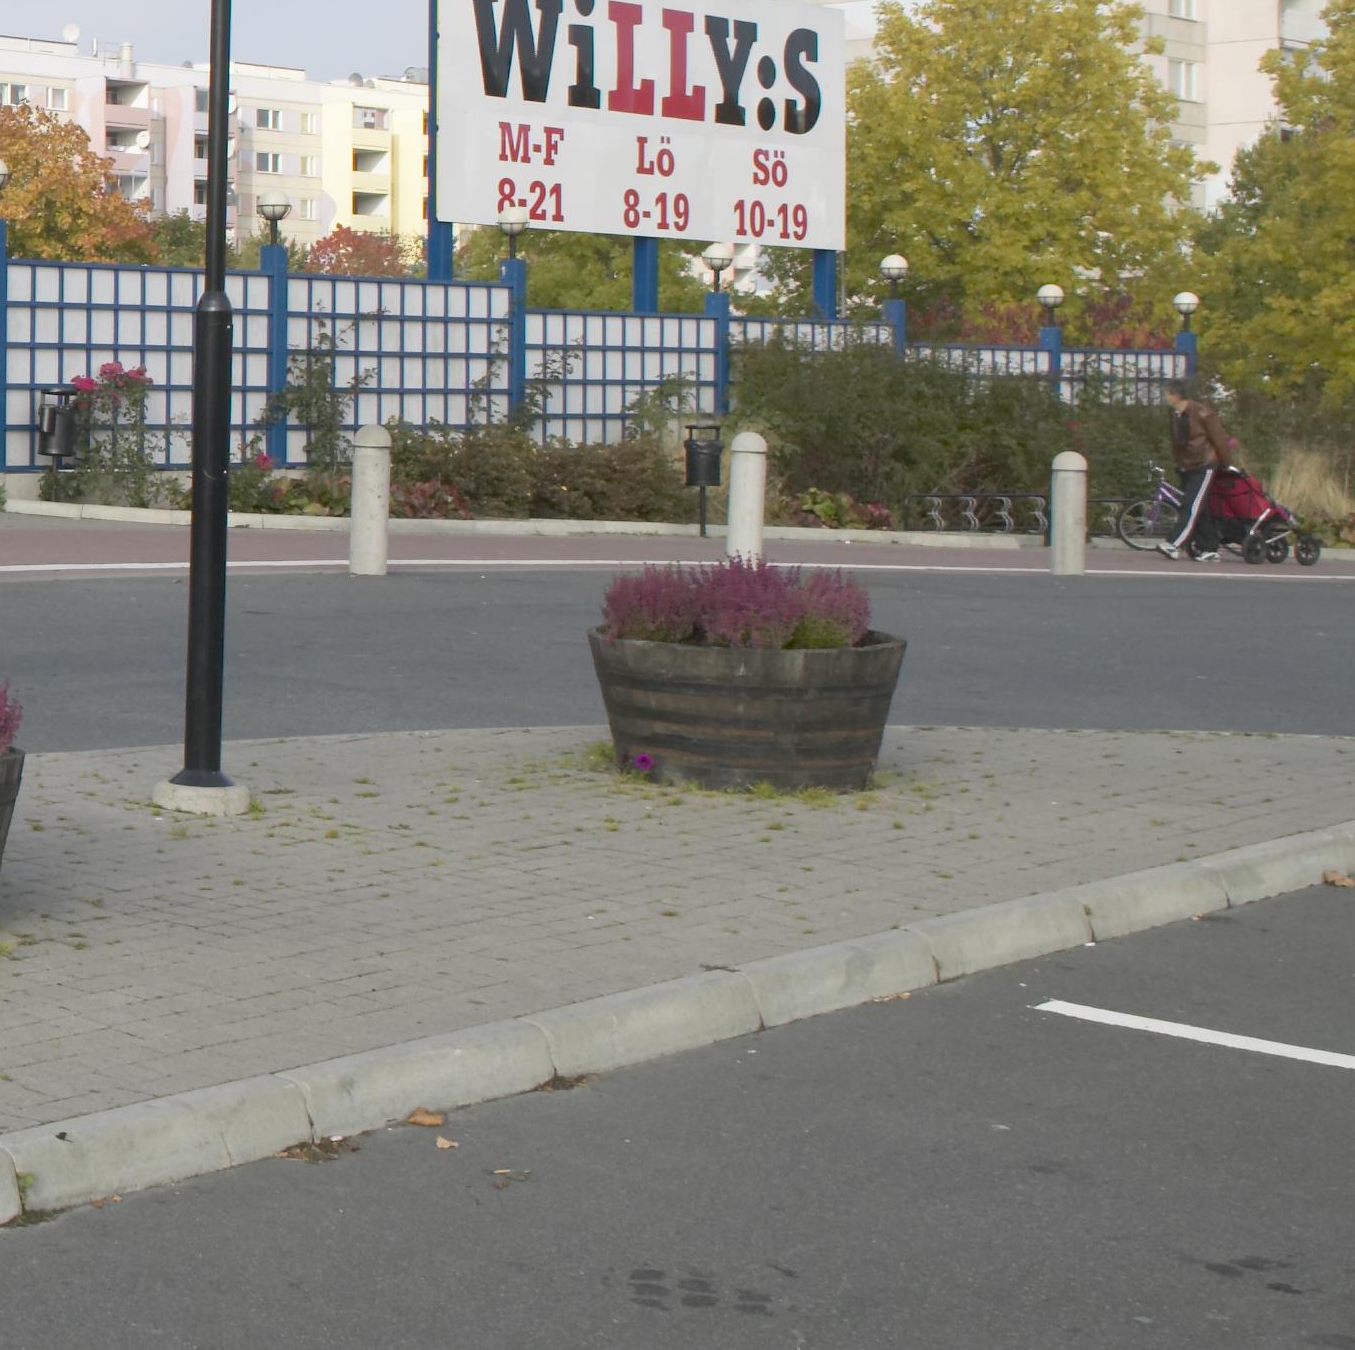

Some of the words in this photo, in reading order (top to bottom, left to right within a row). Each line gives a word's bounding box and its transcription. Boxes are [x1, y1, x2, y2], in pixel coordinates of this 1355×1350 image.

[498, 121, 565, 166] M-F
[636, 137, 676, 177] Lö
[752, 149, 789, 187] Sö
[497, 178, 565, 223] 8-21
[623, 189, 690, 232] 8-19
[733, 200, 808, 240] 10-19
